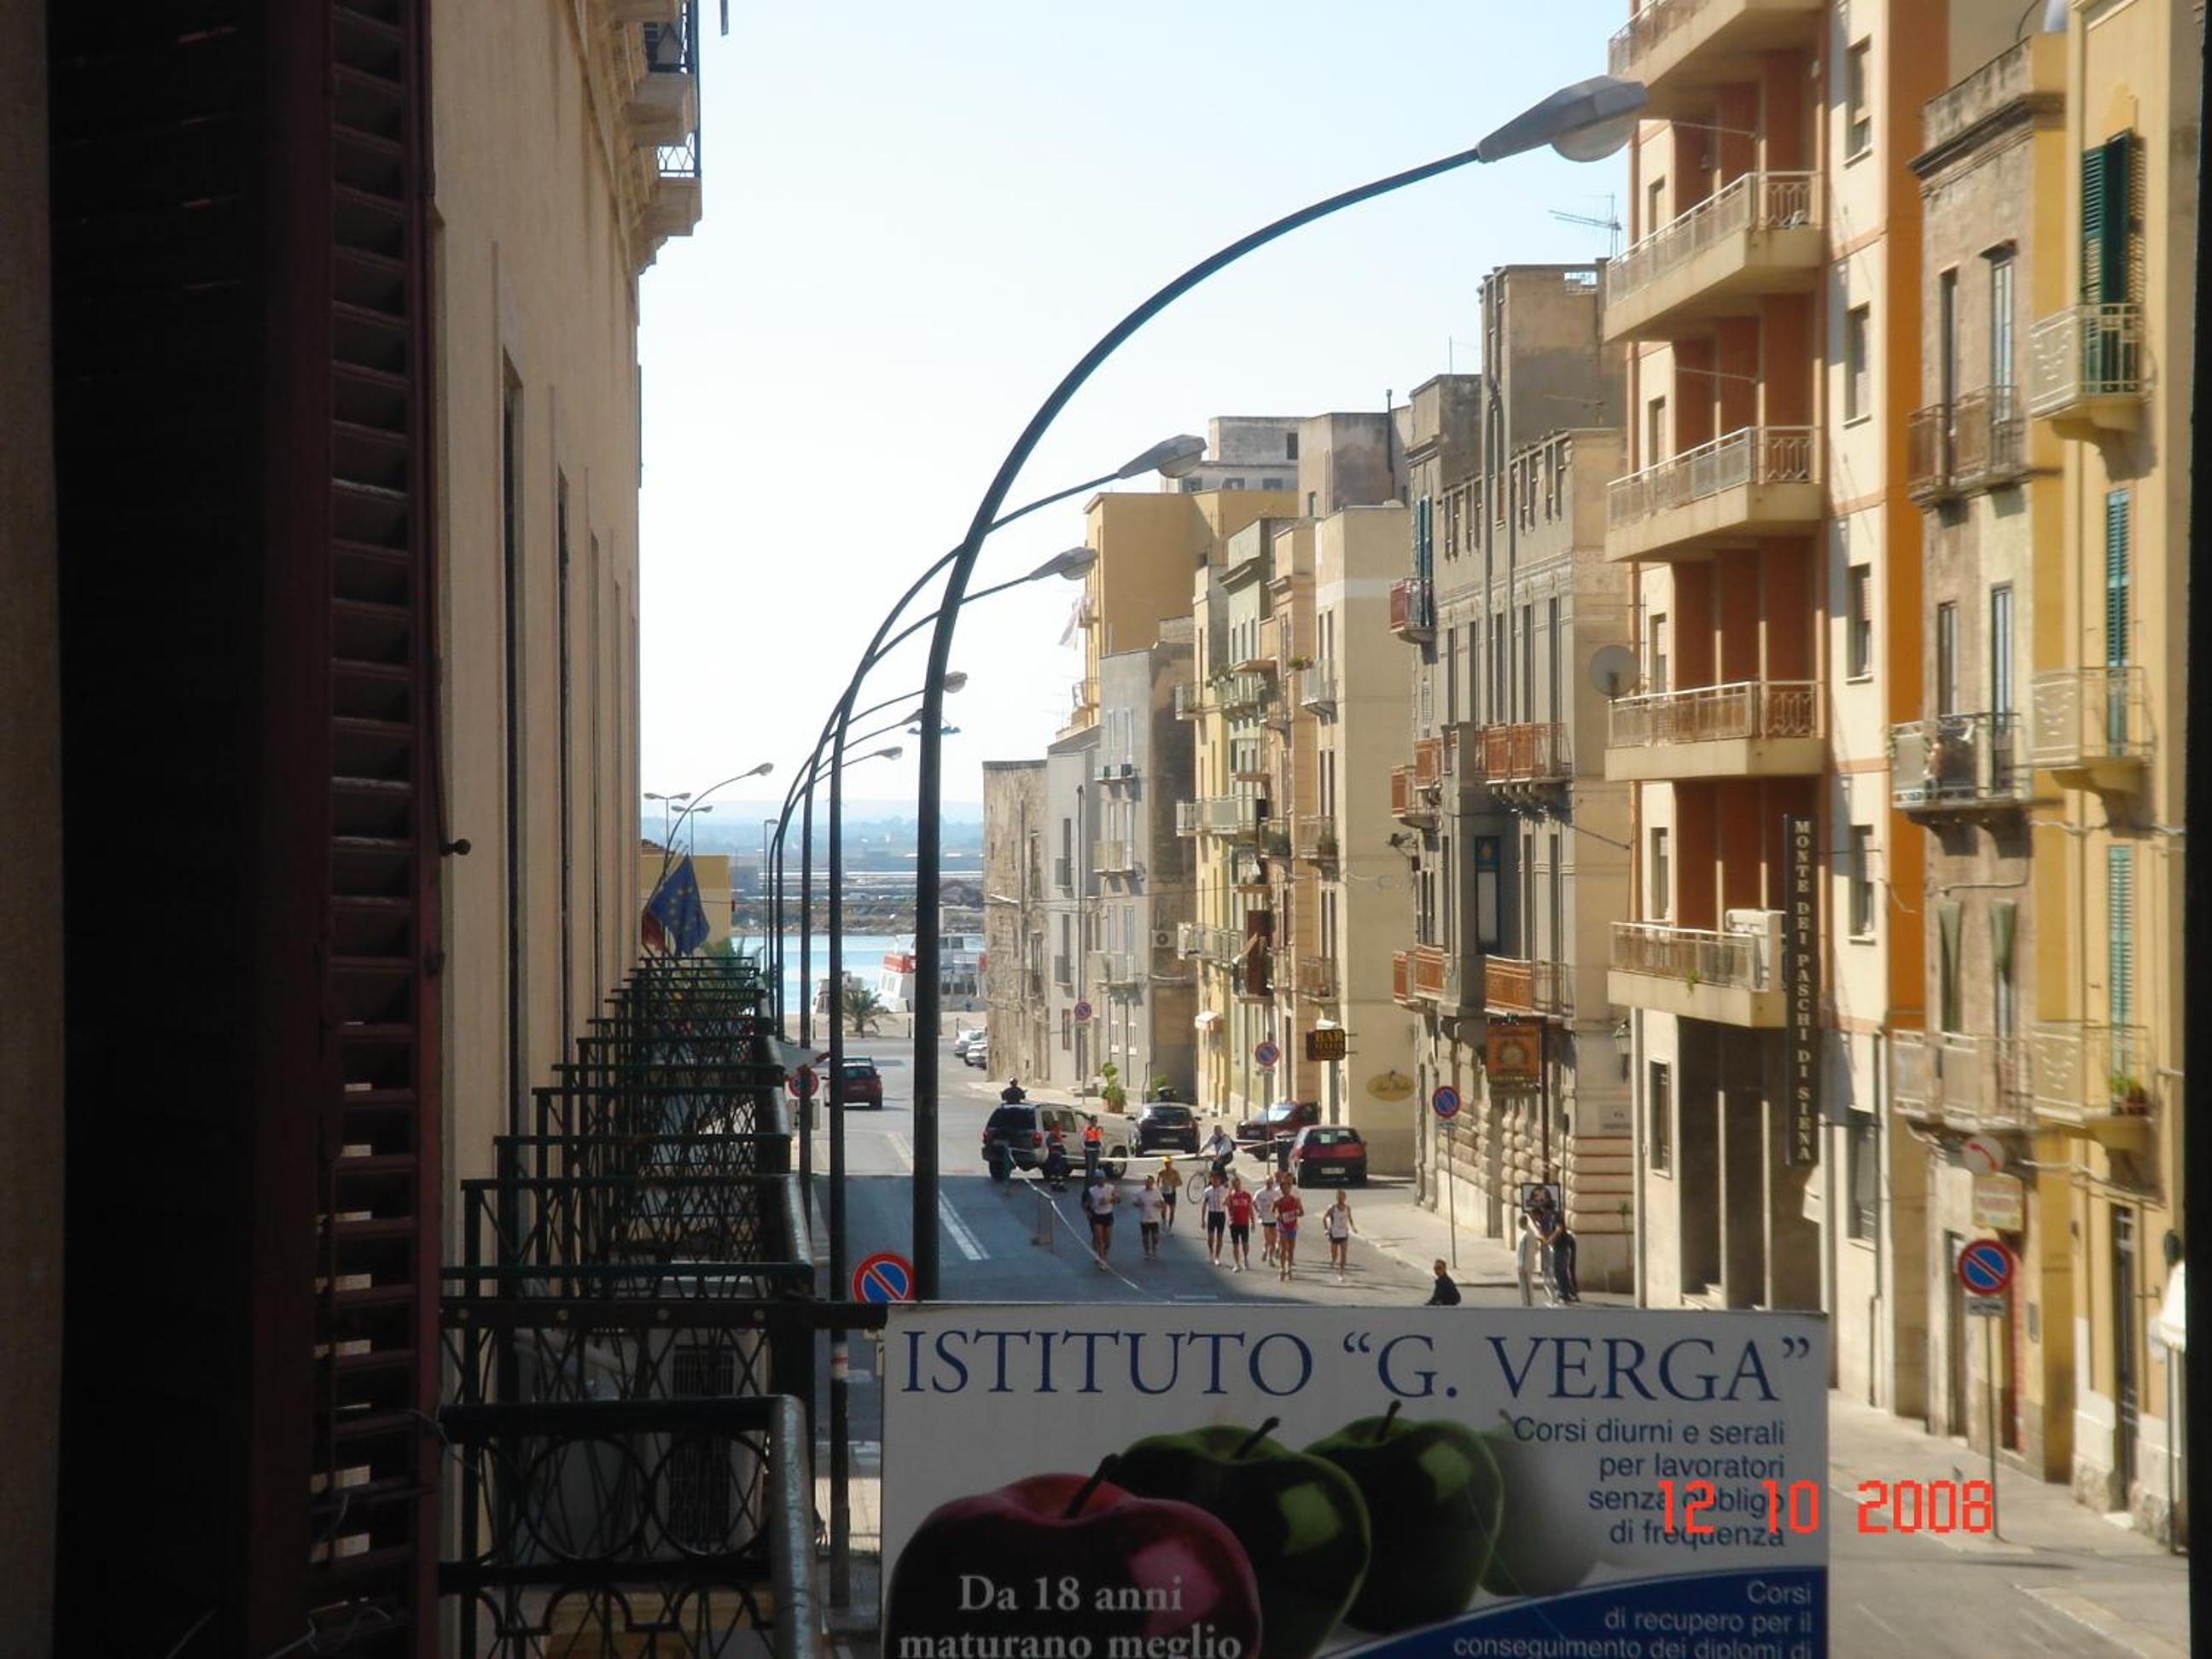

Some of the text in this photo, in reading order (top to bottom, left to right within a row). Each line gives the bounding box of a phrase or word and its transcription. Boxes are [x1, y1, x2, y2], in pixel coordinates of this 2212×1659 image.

[1795, 820, 1811, 1159] MONTE DEI PASCHI DI SIENA
[901, 1330, 1313, 1395] ISTITUTO
[1513, 1417, 1784, 1445] Corsi diurni e serali
[1599, 1452, 1784, 1481] per lavoratori
[1610, 1521, 1785, 1551] di frequenza
[958, 1575, 1184, 1611] Da 18 anni
[1747, 1580, 1811, 1604] Corsi
[1604, 1608, 1812, 1636] di recupero per il
[899, 1624, 1242, 1659] maturano meglio
[1453, 1635, 1812, 1659] conseguimento dei diplomi di
